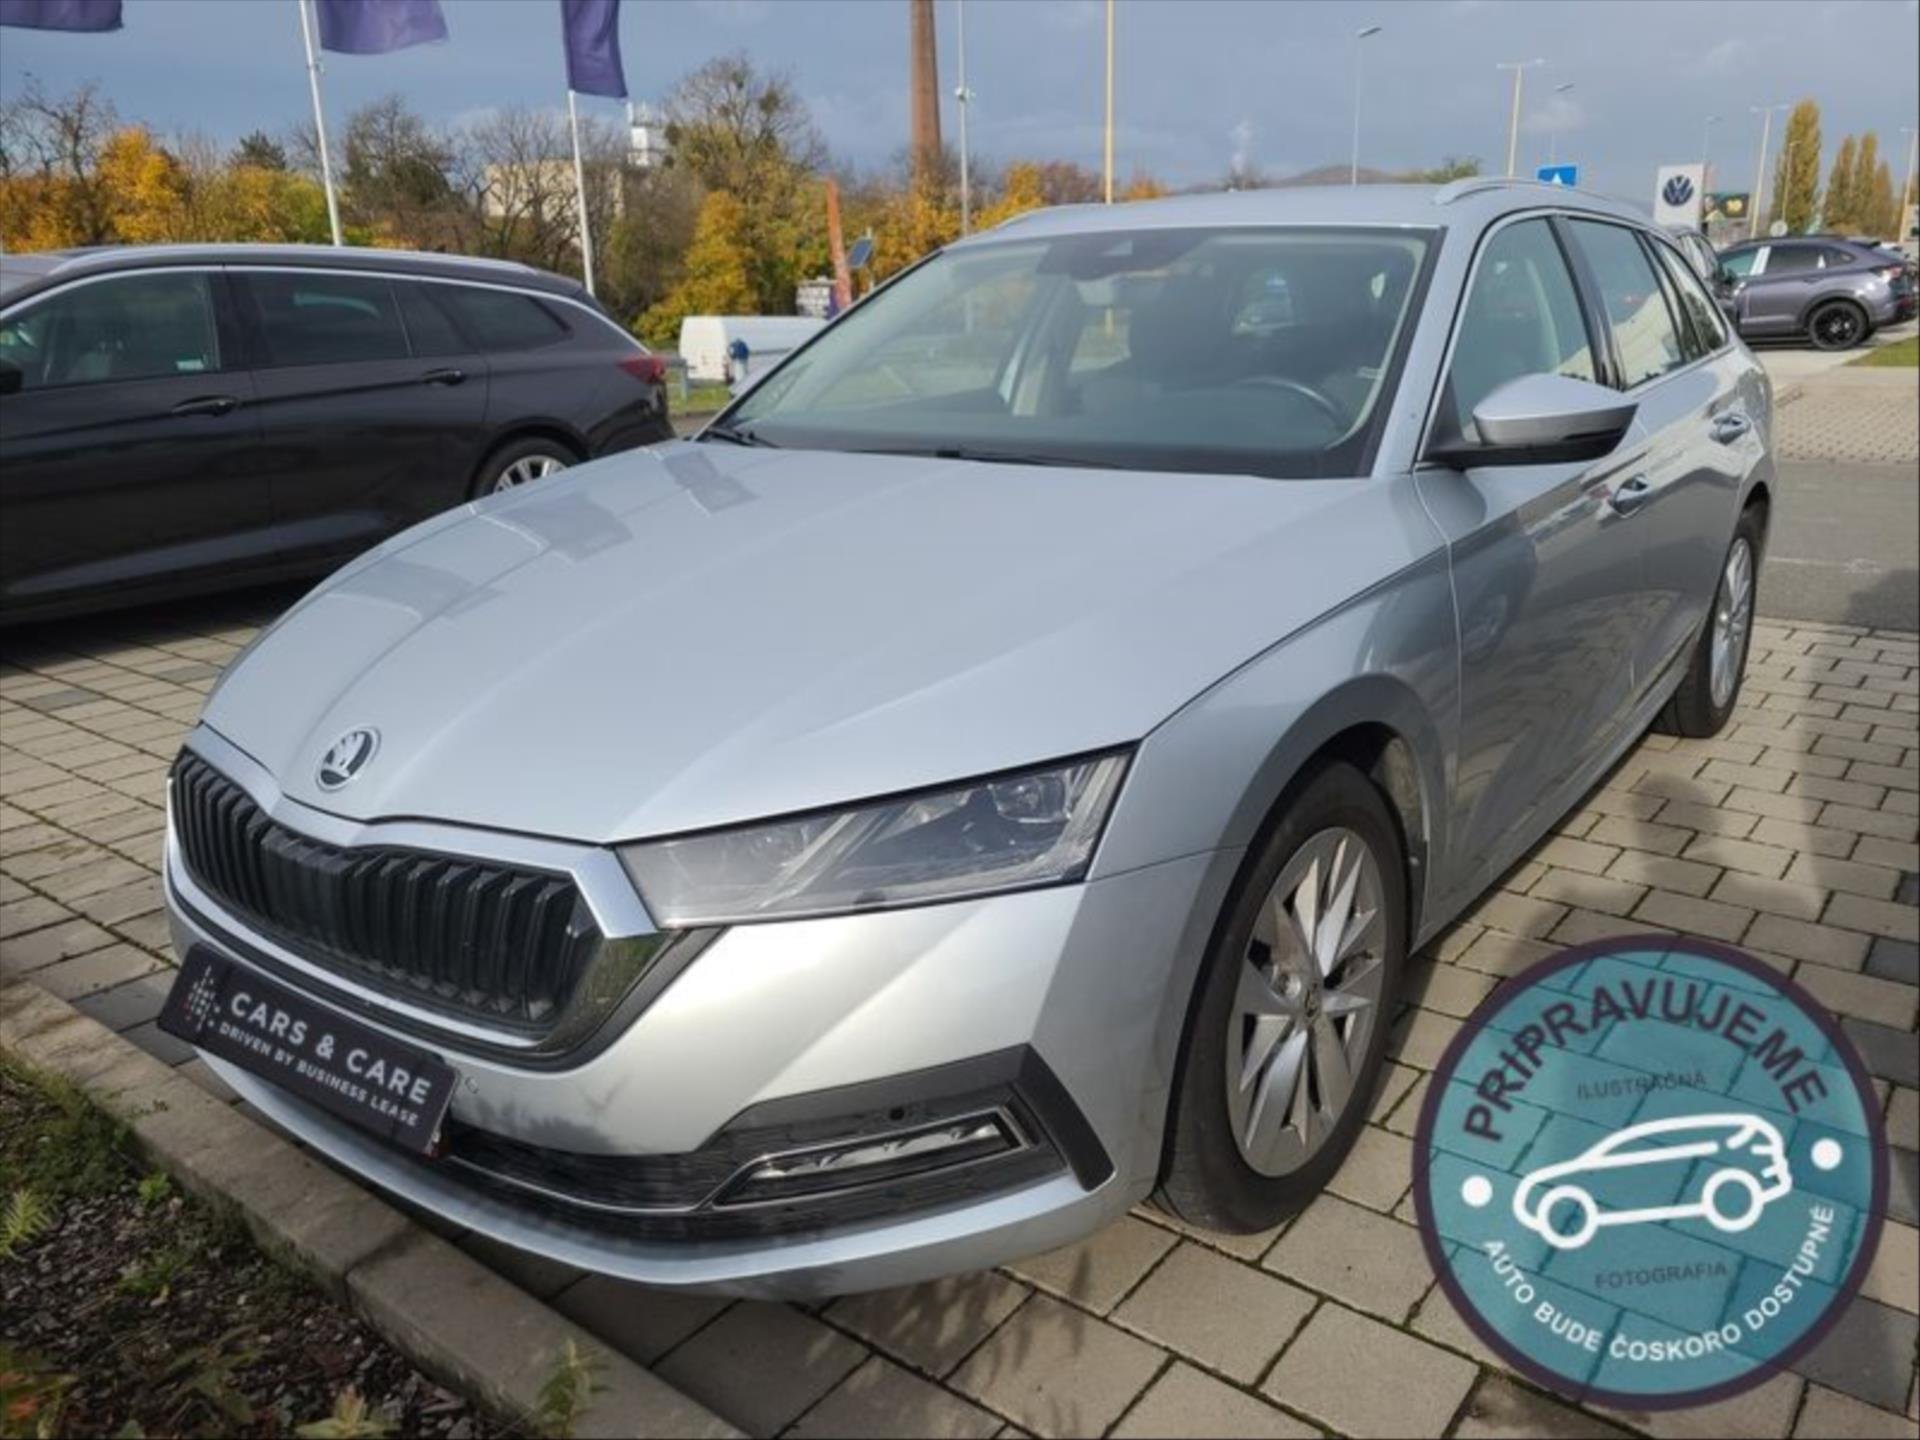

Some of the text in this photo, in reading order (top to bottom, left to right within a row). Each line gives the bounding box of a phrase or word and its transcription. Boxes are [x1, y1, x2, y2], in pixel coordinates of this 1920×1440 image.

[219, 1021, 419, 1127] DRIVEN BY BUSINESS LEASE
[231, 992, 432, 1105] CARS & CARE
